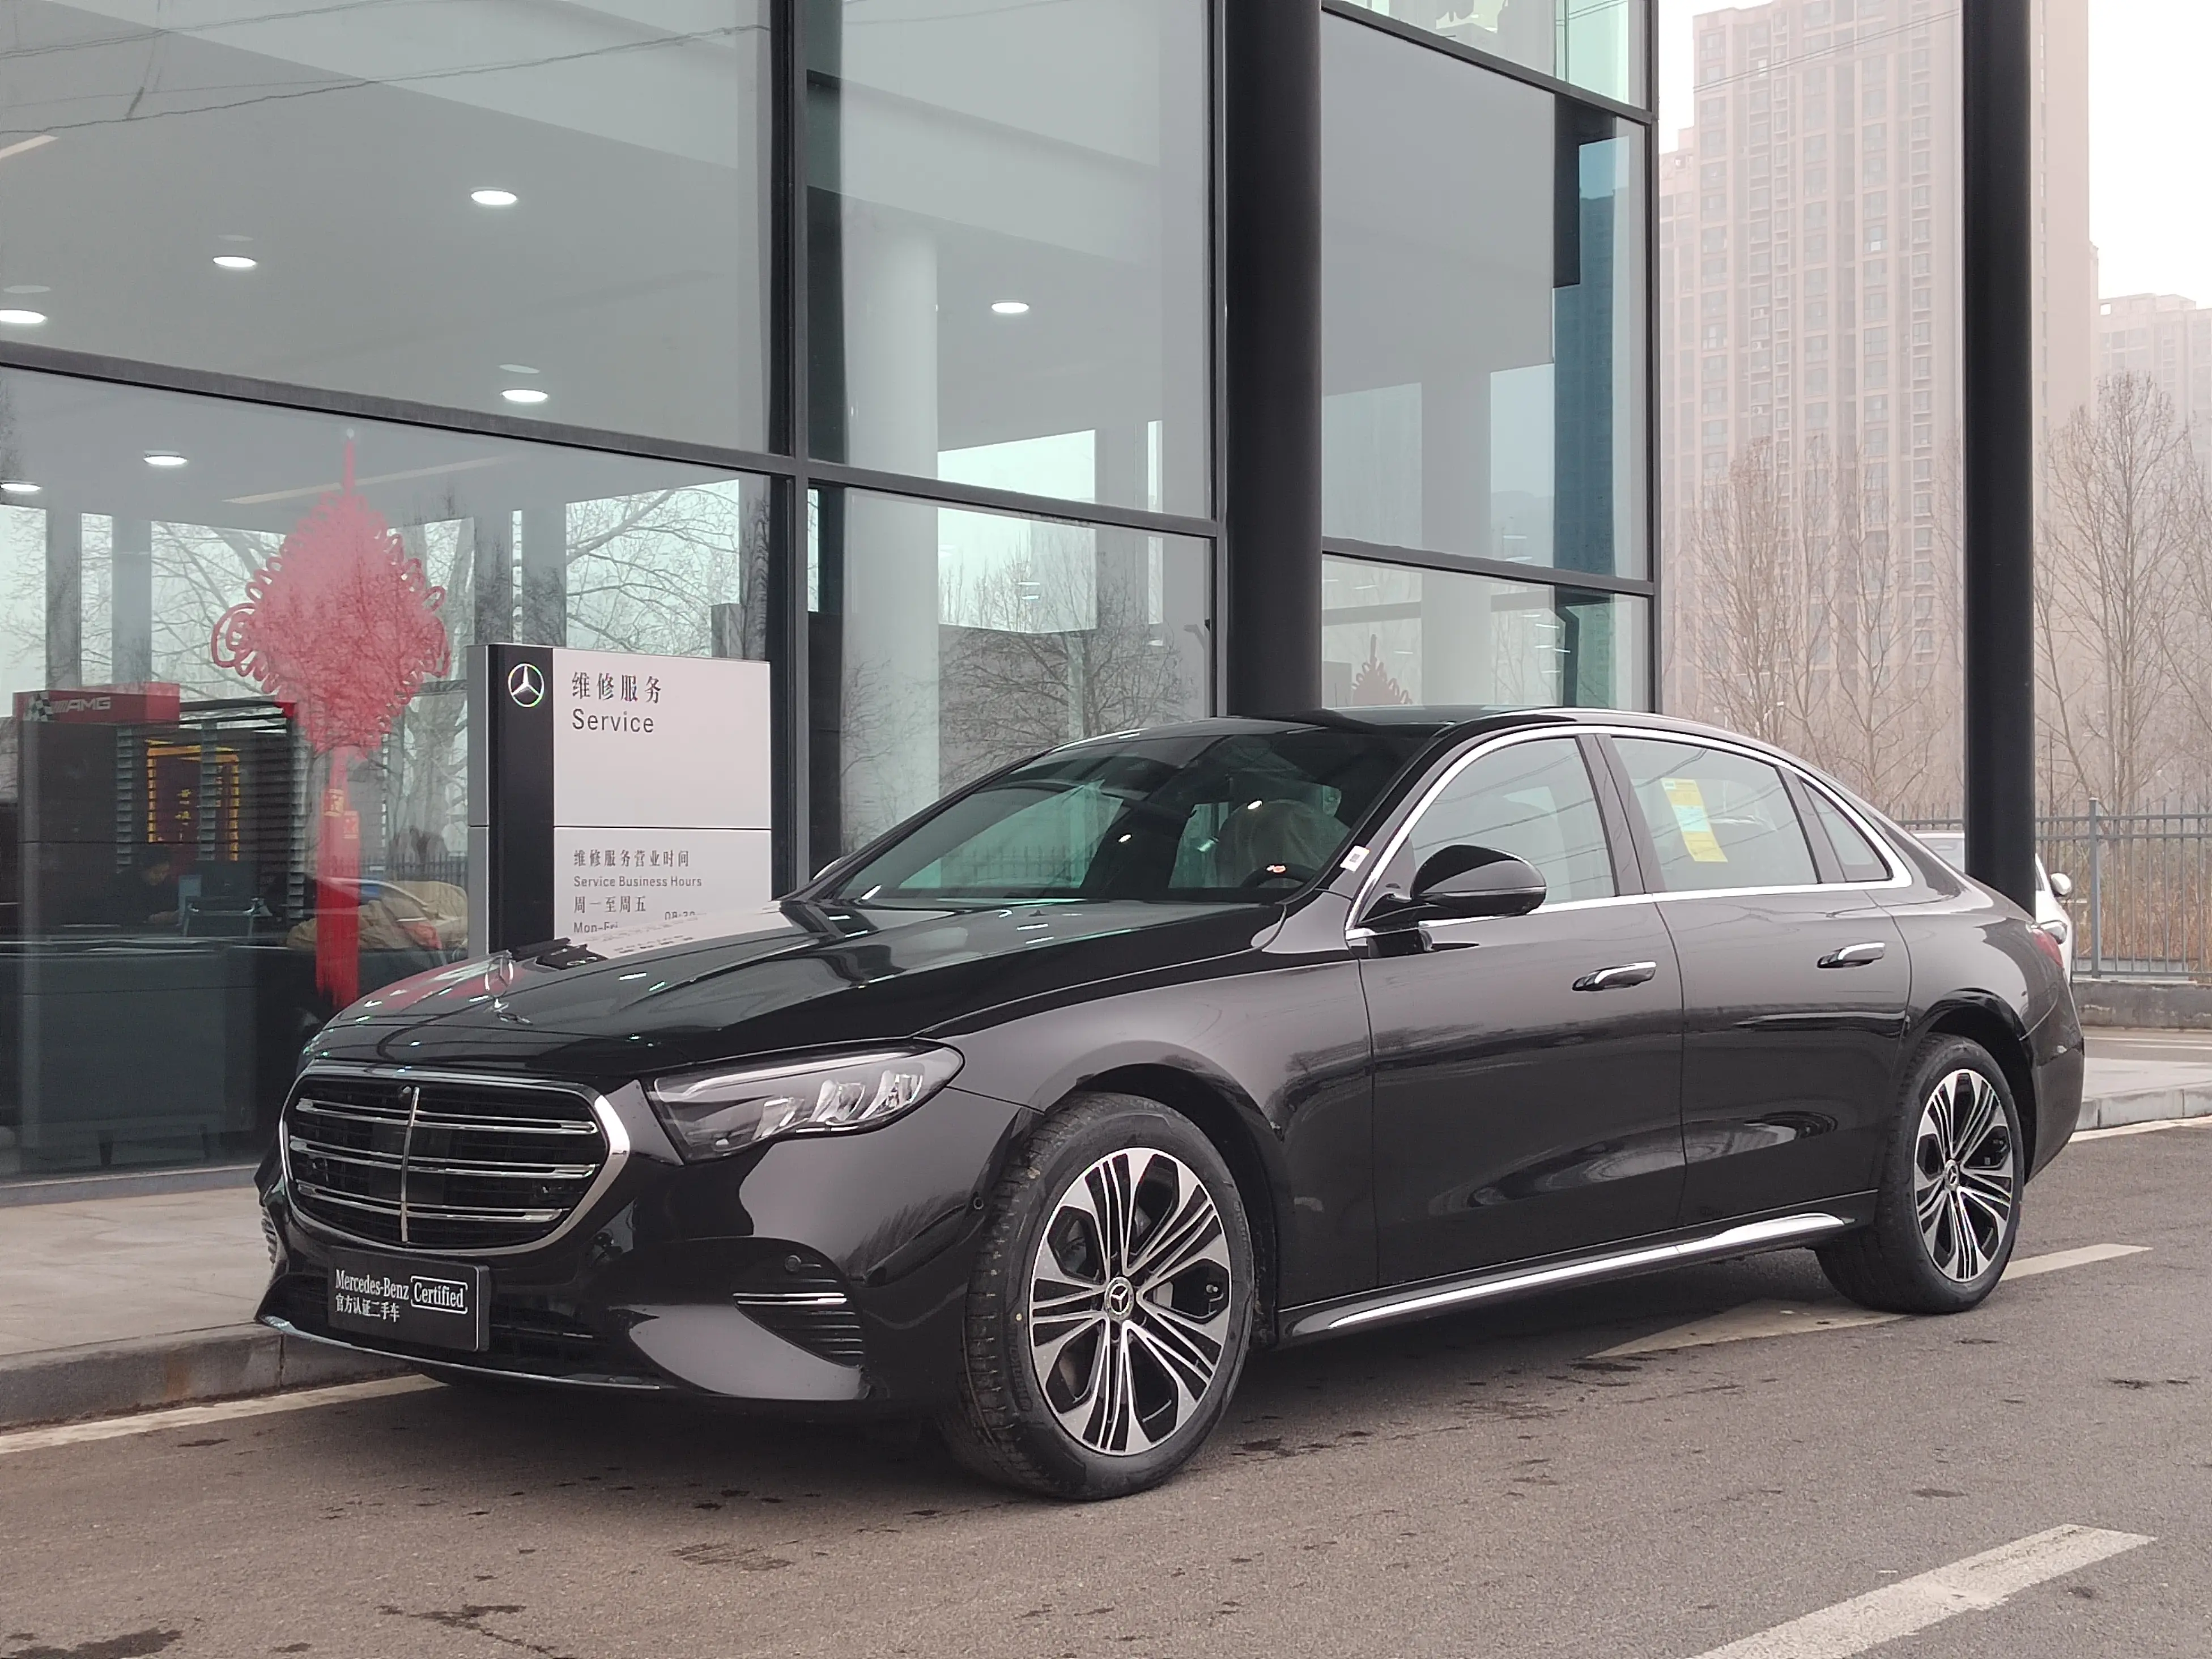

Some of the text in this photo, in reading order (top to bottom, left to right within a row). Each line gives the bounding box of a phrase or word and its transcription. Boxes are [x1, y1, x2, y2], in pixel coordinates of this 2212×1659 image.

[572, 671, 661, 704] 维修服务
[572, 708, 654, 733] Service
[573, 849, 689, 867] 维修服务营业时间
[573, 875, 703, 887] Service Business Hours
[573, 895, 646, 914] 周一至周五
[335, 1268, 464, 1308] Mercedes-Benz Certified
[335, 1292, 401, 1323] 官方认证二手车
